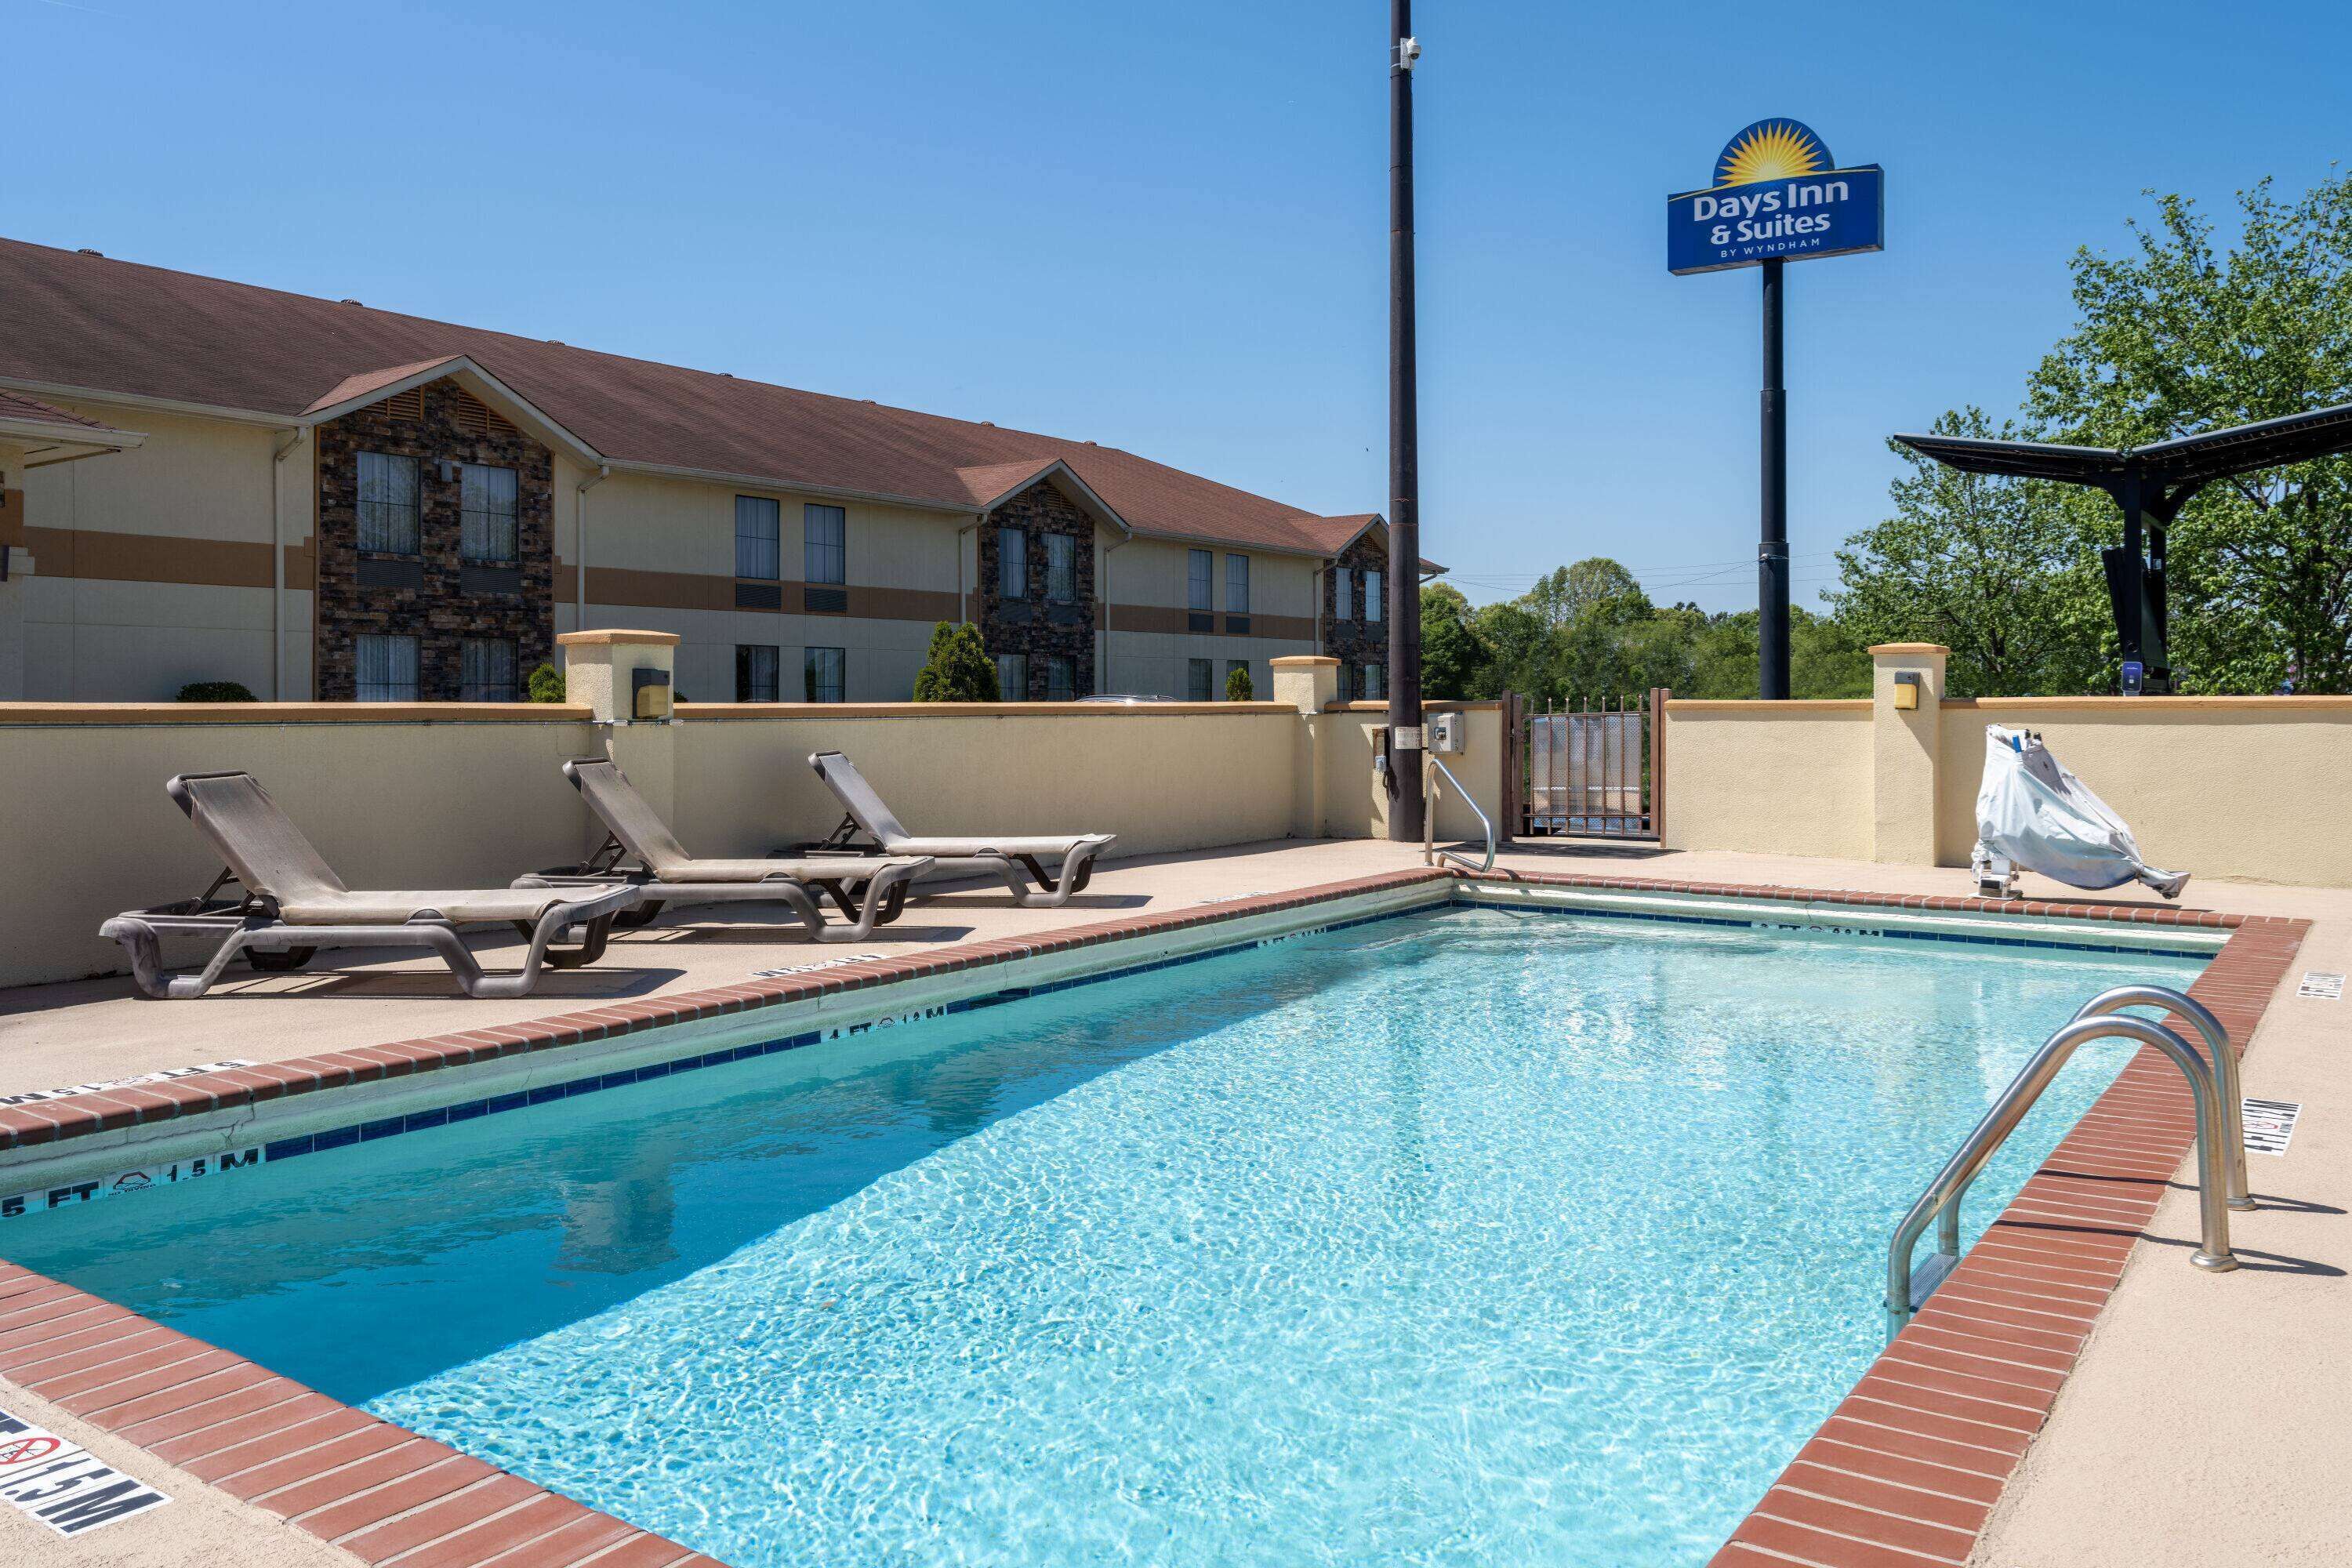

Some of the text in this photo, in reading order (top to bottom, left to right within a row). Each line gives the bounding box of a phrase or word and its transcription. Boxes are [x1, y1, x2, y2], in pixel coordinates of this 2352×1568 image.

[1694, 181, 1849, 222] Days Inn
[1711, 213, 1831, 245] & Suites
[1721, 238, 1820, 258] BY WYNDHAM
[849, 1022, 872, 1036] FT
[159, 1067, 210, 1079] FT
[1, 1196, 27, 1217] 5
[48, 1181, 100, 1209] FT
